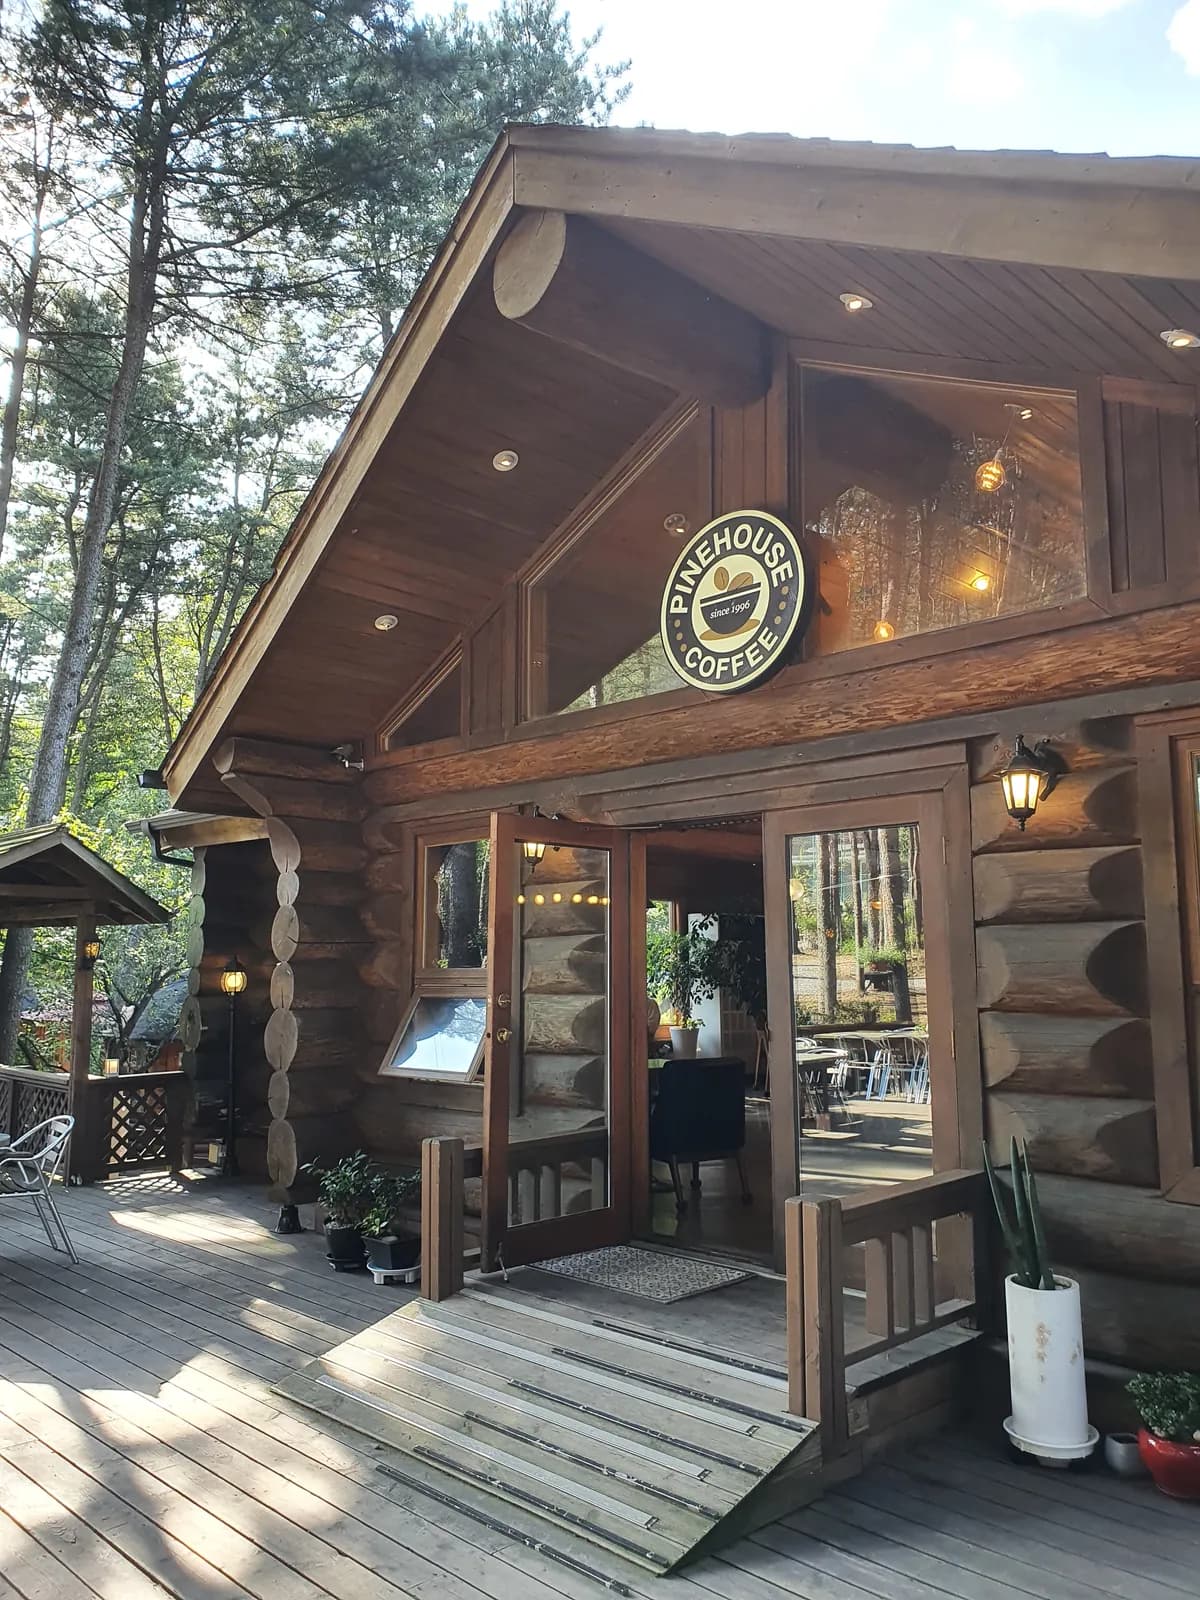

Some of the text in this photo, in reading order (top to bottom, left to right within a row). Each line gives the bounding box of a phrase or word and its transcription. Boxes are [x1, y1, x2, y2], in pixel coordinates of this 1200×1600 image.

[670, 523, 794, 614] PINEHOUSE
[710, 600, 750, 619] since 1996
[685, 627, 779, 679] COFFEE
